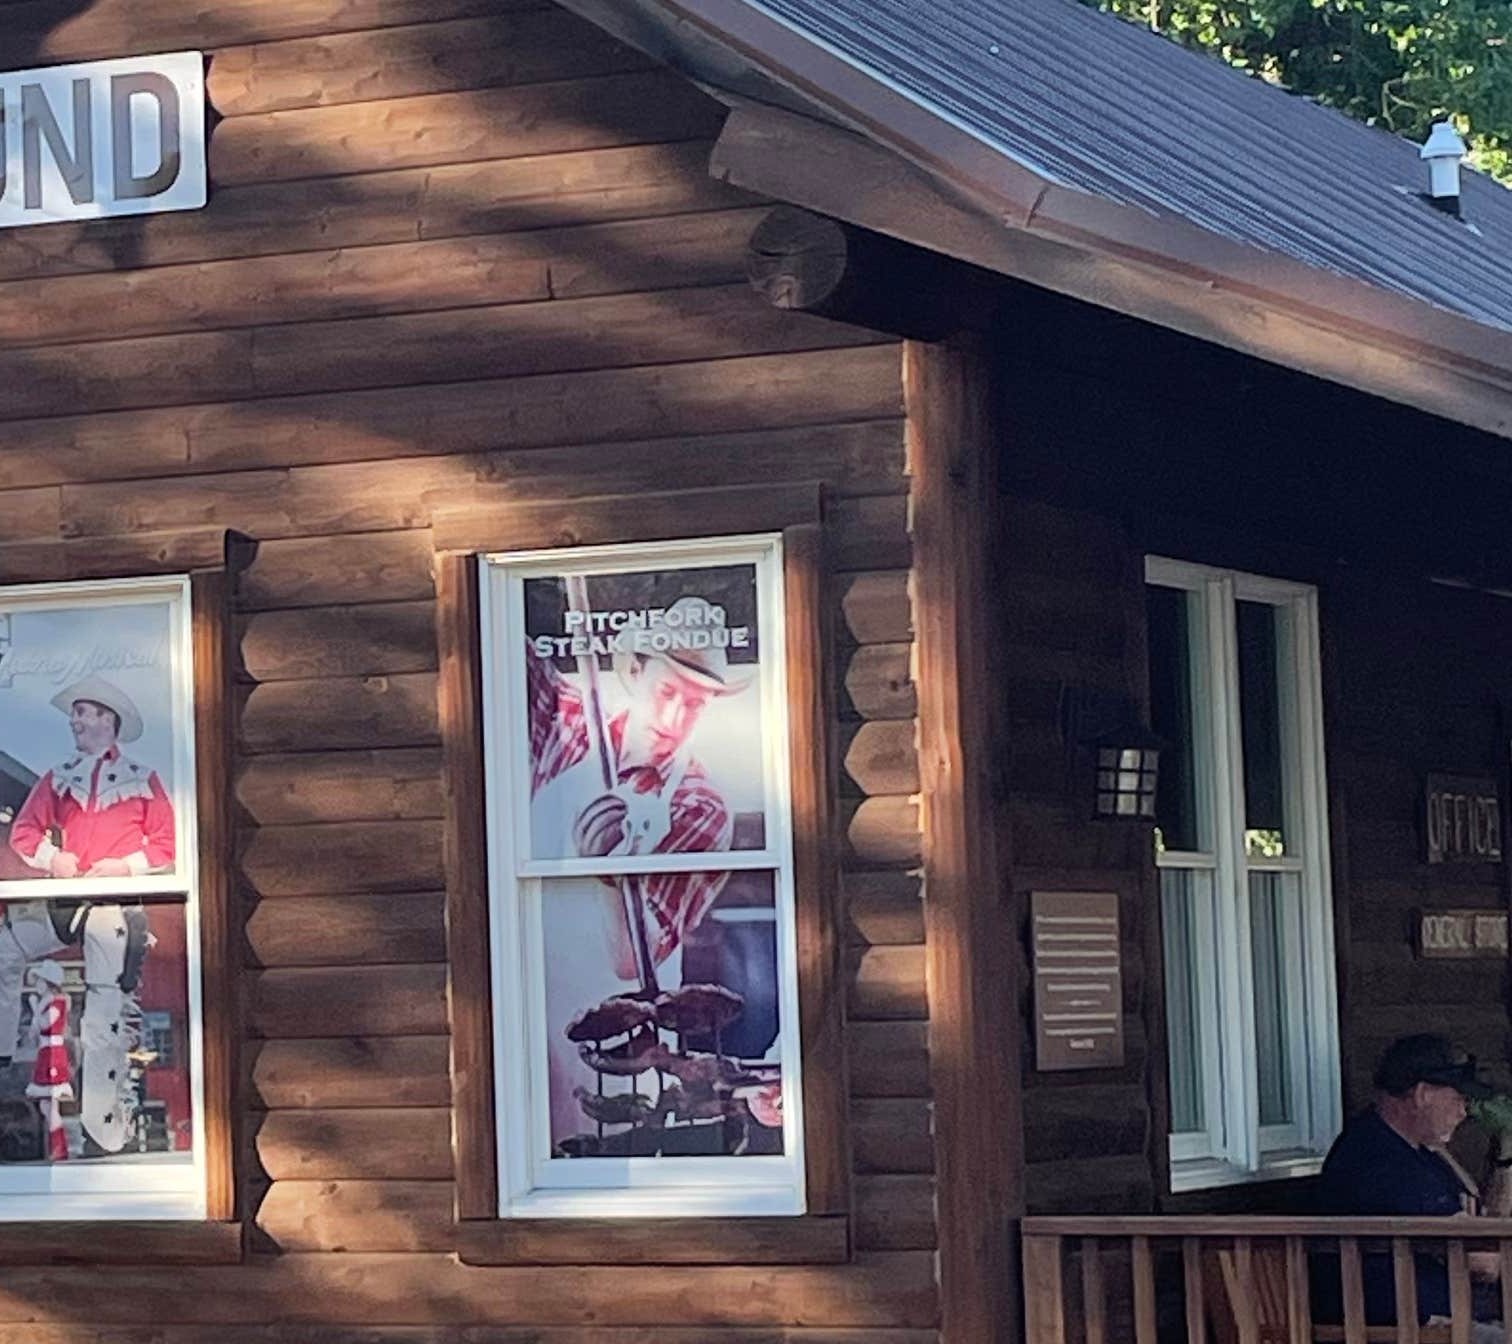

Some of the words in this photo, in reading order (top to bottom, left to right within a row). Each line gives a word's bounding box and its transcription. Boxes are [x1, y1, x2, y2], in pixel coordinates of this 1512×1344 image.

[564, 606, 726, 633] PITCHFORK
[535, 634, 625, 658] STEAK
[633, 626, 750, 652] FONDUE
[1427, 792, 1501, 856] OFFICE
